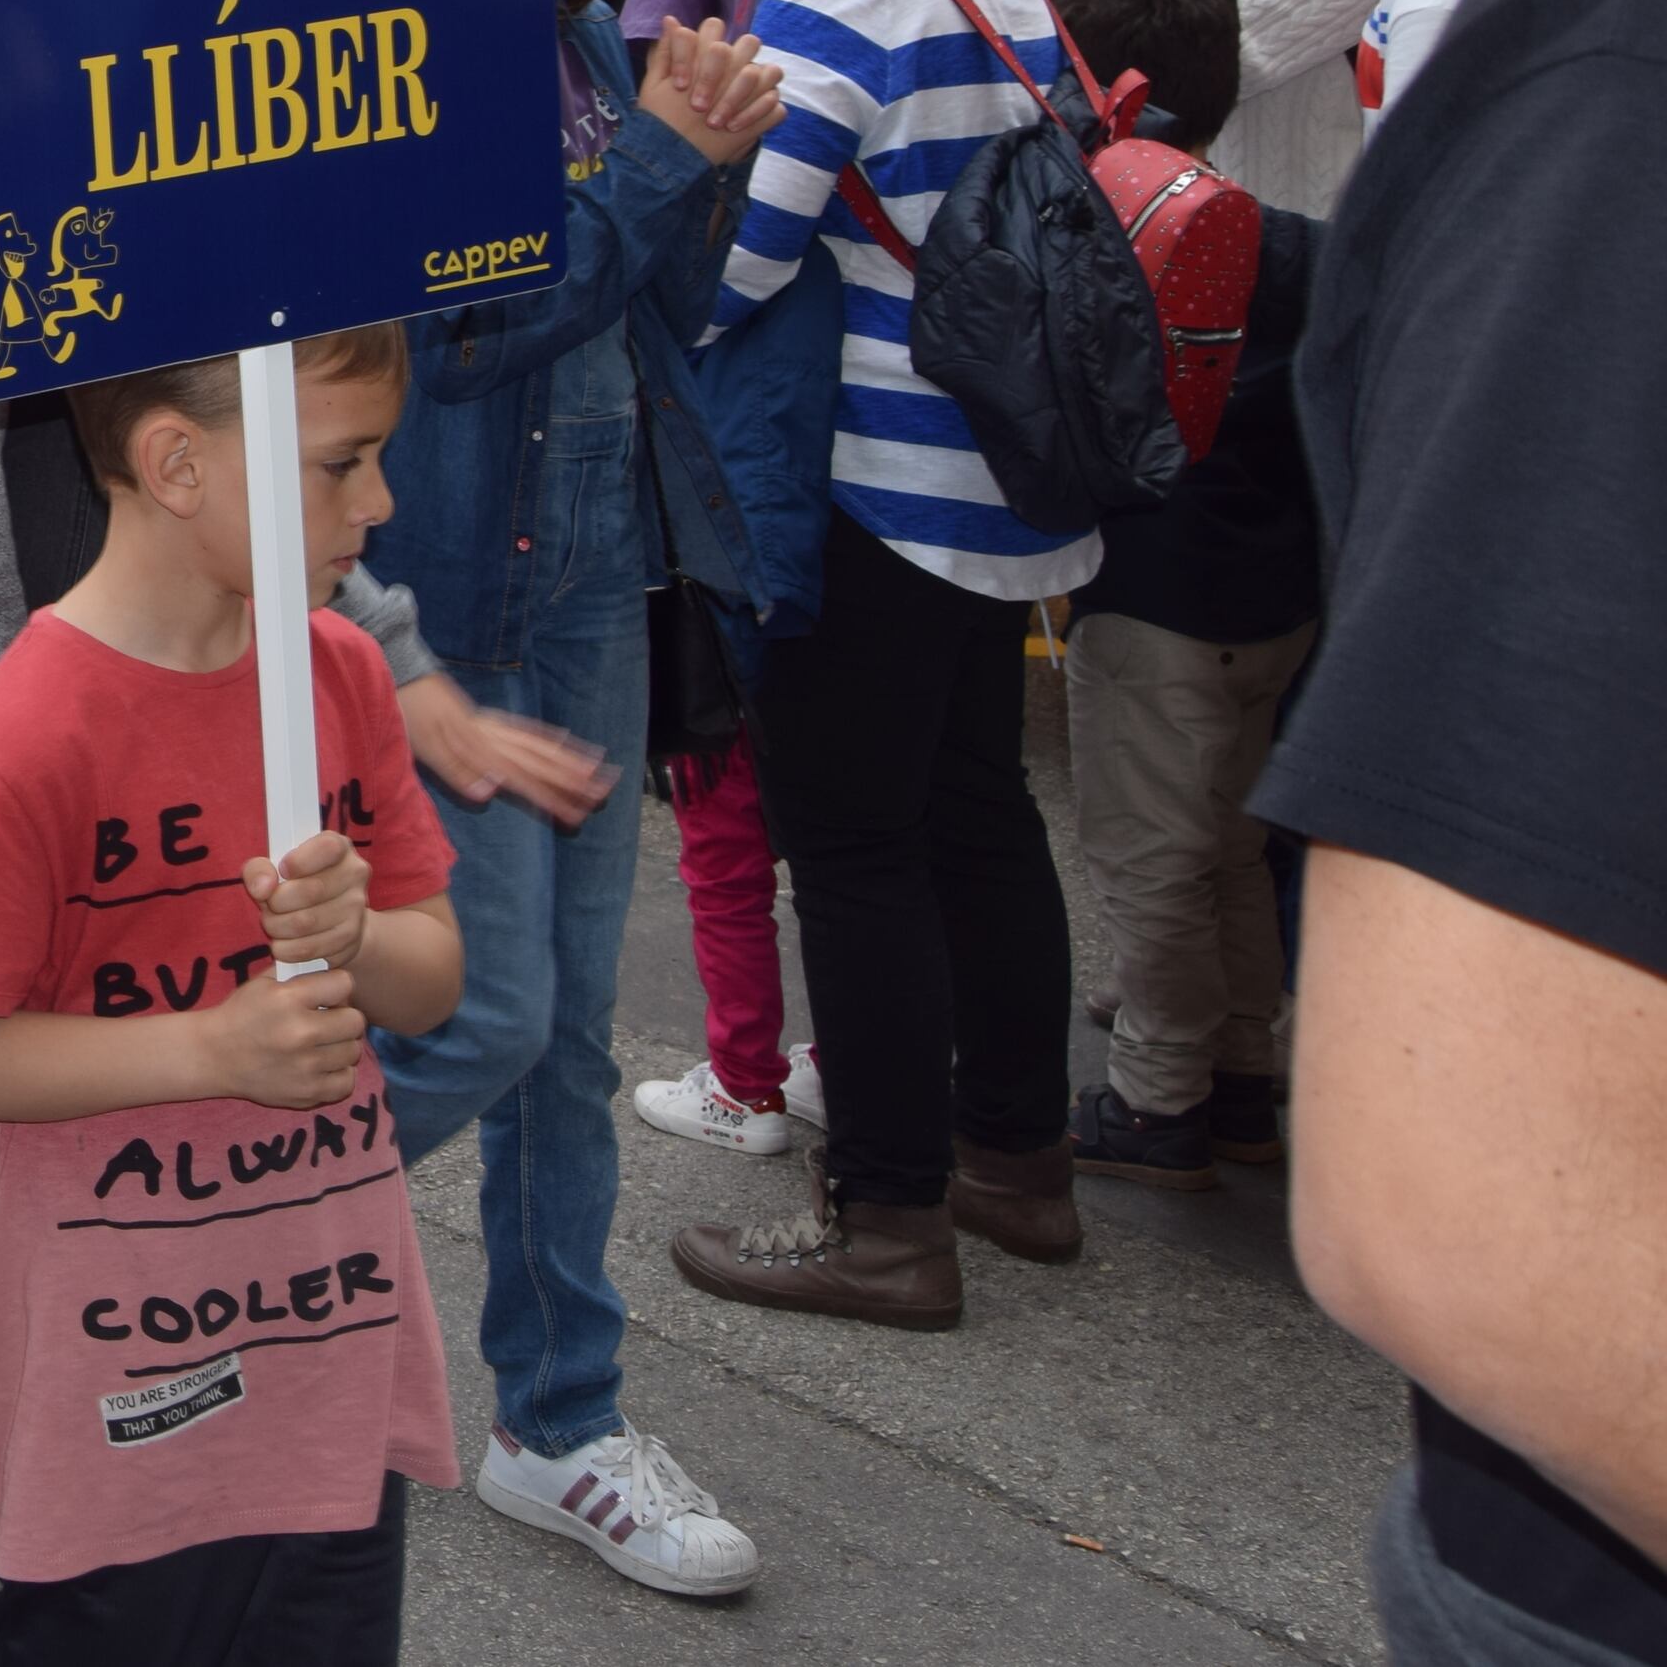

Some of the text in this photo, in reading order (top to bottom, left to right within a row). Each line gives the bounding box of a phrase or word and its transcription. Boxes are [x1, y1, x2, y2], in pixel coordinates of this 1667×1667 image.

[94, 803, 209, 884] BE
[94, 944, 271, 1019] BUT
[94, 1093, 391, 1200] ALWAY
[82, 1251, 394, 1345] COOLER
[106, 1357, 232, 1411] YOU ARE STRONGER
[122, 1387, 228, 1437] THAT YOU THINK.
